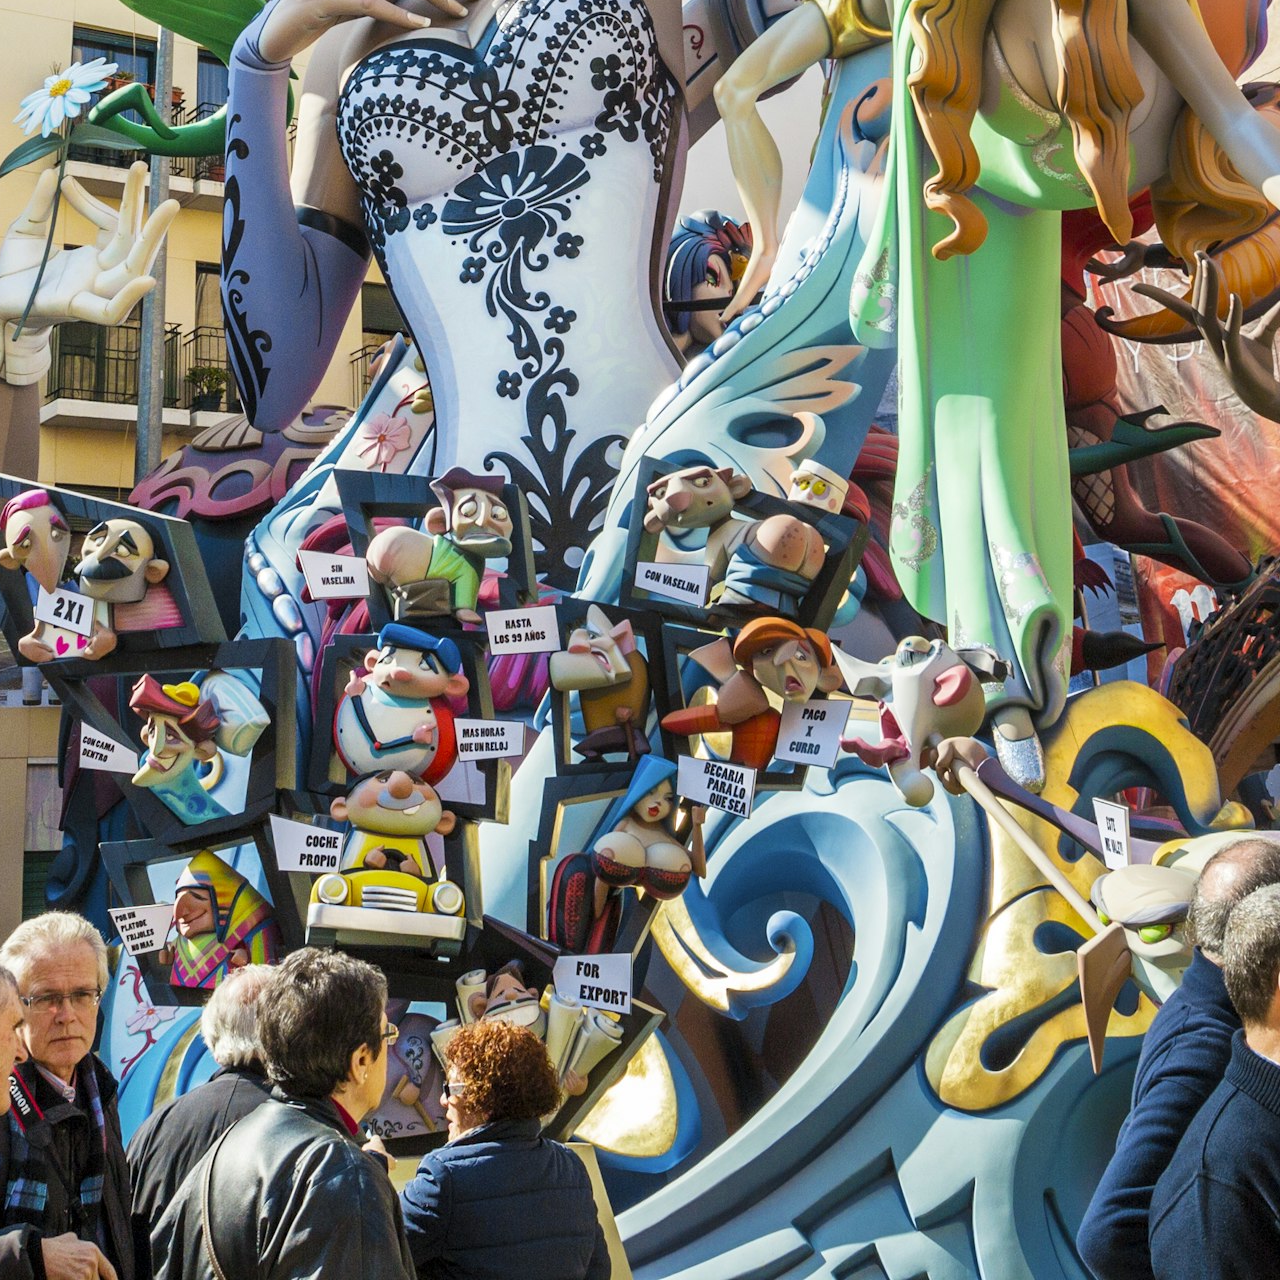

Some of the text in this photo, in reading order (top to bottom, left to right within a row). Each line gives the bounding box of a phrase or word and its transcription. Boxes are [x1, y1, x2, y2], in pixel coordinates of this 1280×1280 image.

[331, 564, 343, 573] SIN
[321, 576, 355, 586] VASELINA
[645, 569, 700, 595] CON VASELINA
[505, 618, 532, 629] HASTA
[494, 630, 546, 644] LOS 99 AÑOS
[462, 727, 505, 738] MAS HORAS
[805, 725, 814, 737] X
[83, 736, 115, 753] CON CAMA
[460, 741, 508, 753] QUE UN RELOJ
[789, 741, 821, 755] CURRO
[82, 748, 108, 762] DENTRO
[704, 762, 744, 785] BECARIA
[707, 777, 746, 800] PARA LO
[709, 792, 746, 816] QUE SEA
[306, 835, 339, 849] COCHE
[299, 853, 337, 868] PROPIO
[115, 911, 136, 923] POR UN
[126, 928, 154, 942] FRIJOLES
[131, 939, 154, 952] NO MAS
[576, 961, 600, 979] FOR
[579, 984, 628, 1007] EXPORT
[8, 1076, 31, 1116] Canon
